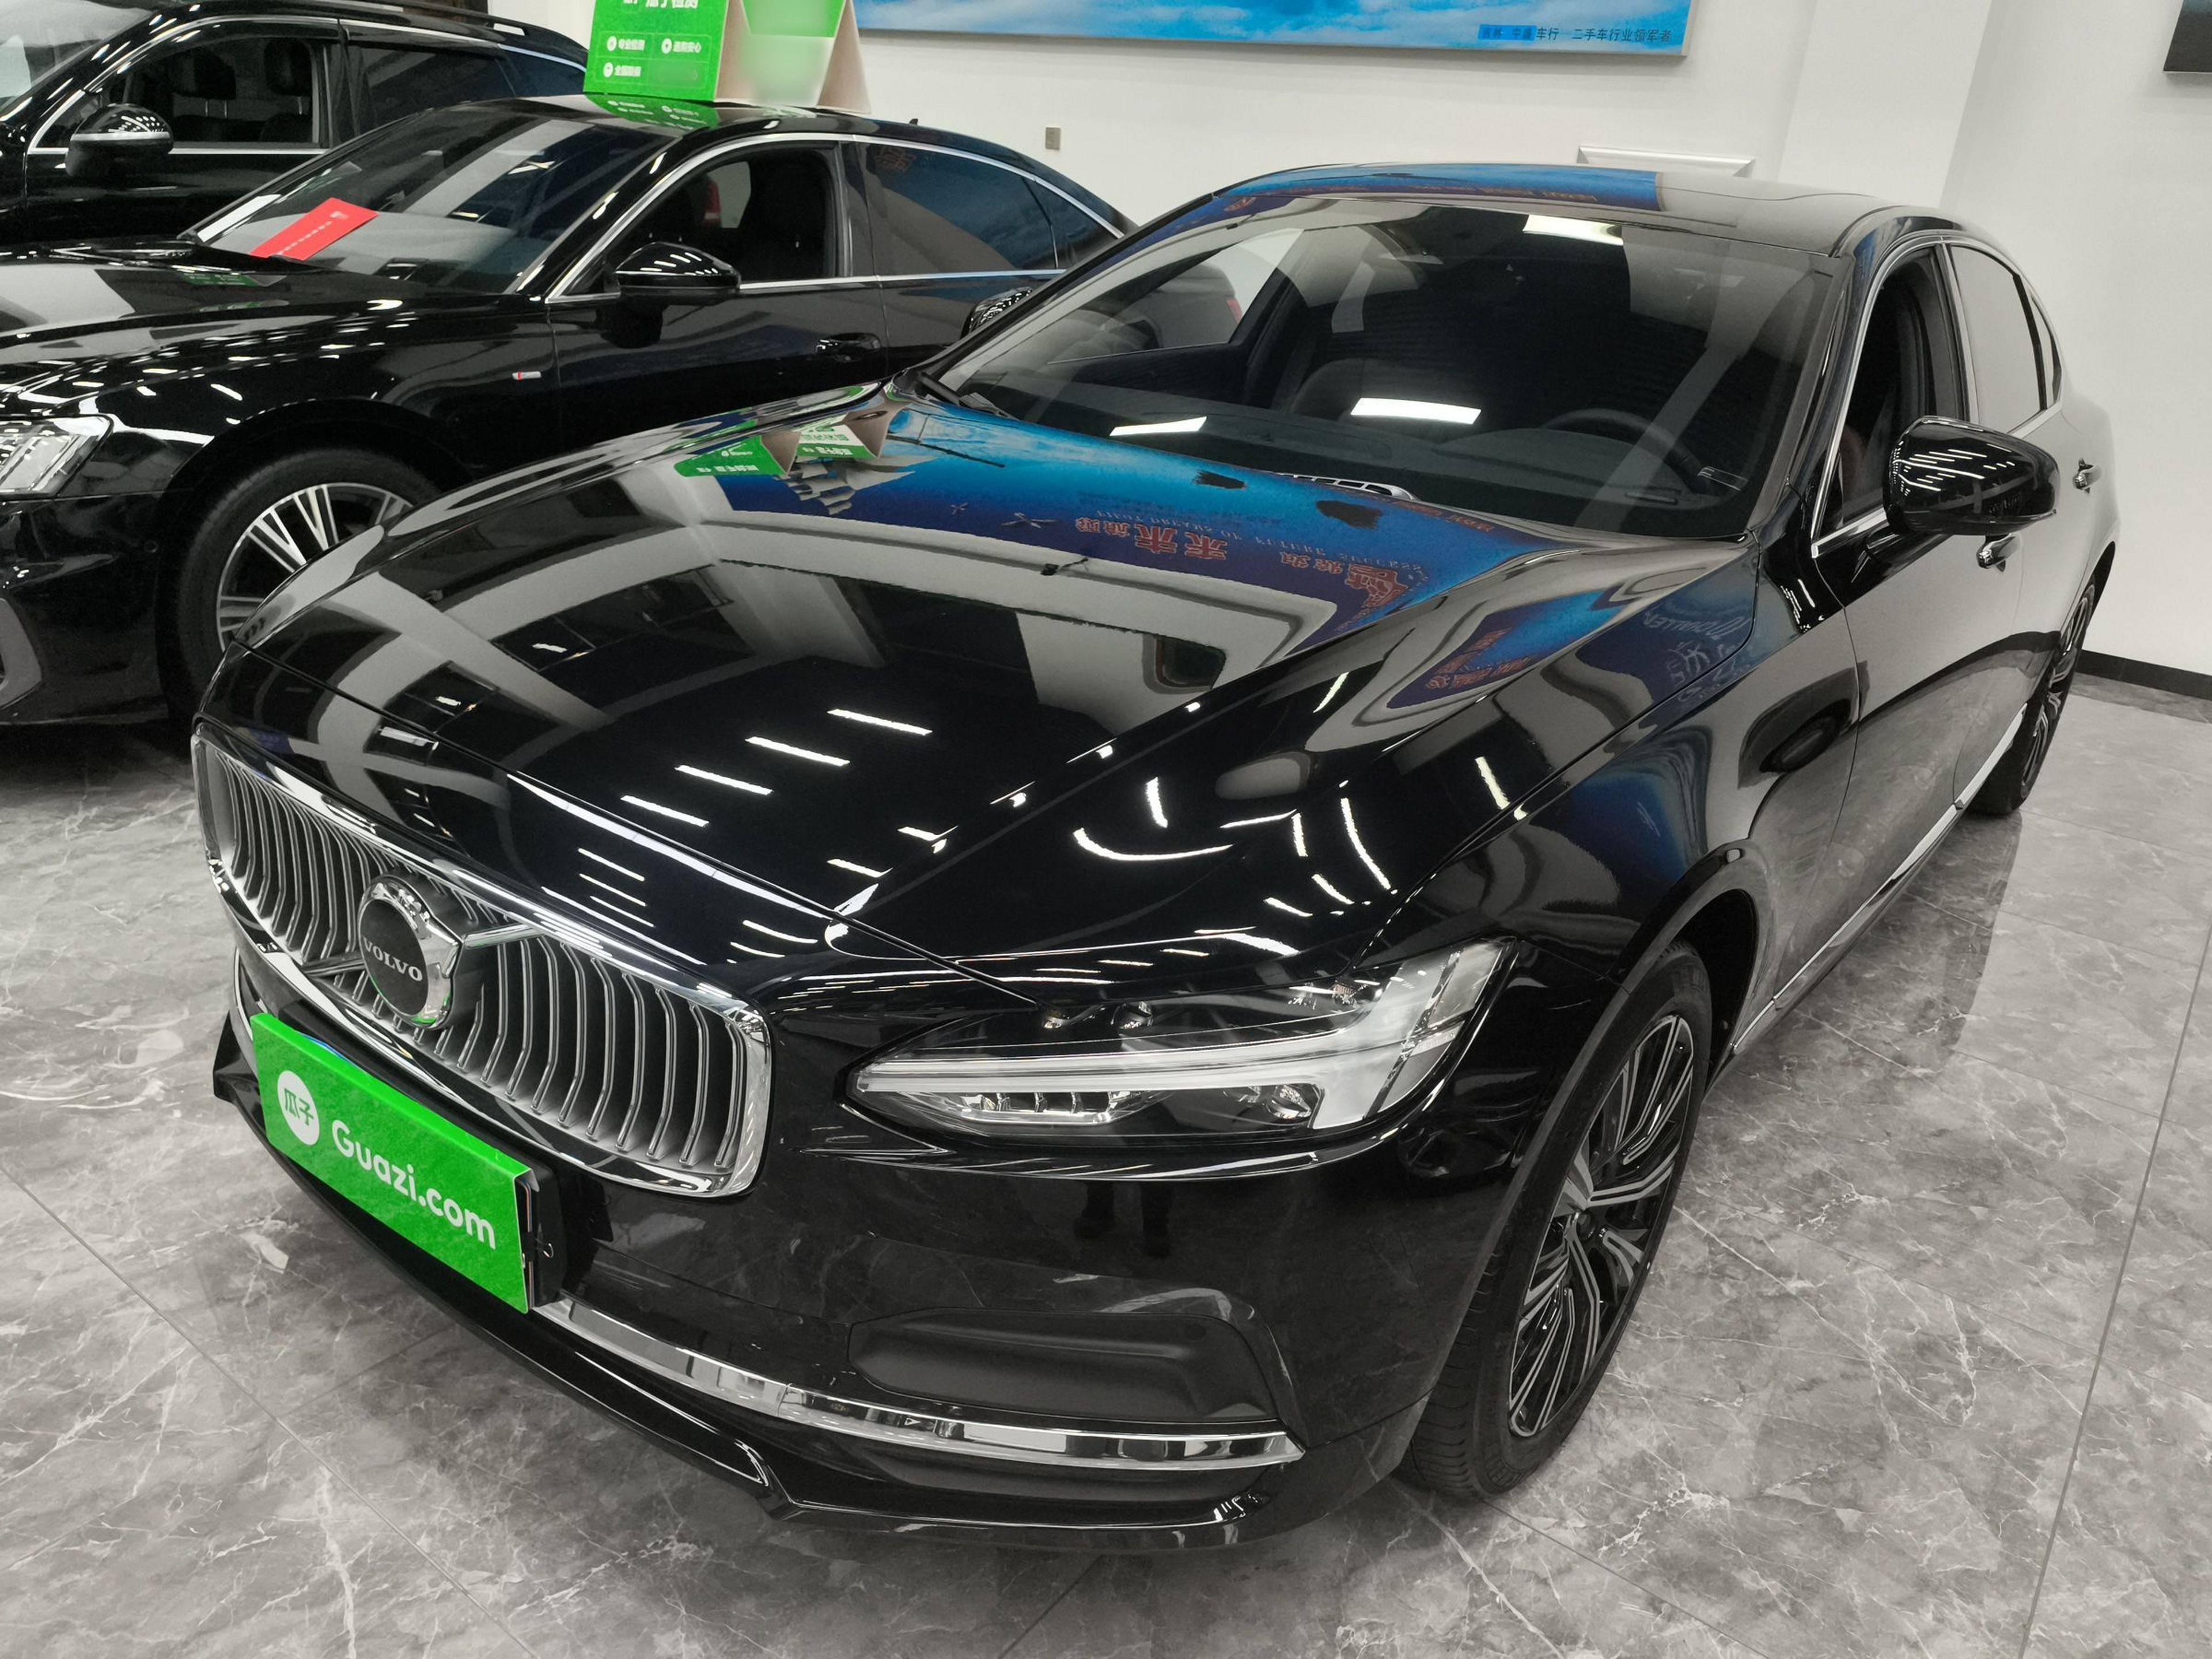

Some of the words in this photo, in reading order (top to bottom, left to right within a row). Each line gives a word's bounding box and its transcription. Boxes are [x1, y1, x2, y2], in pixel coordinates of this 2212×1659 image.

[1572, 28, 1672, 43] 二手车行业领军者
[362, 935, 423, 982] VOLVO
[282, 1087, 315, 1126] 瓜子
[331, 1119, 497, 1250] Guazi.com
